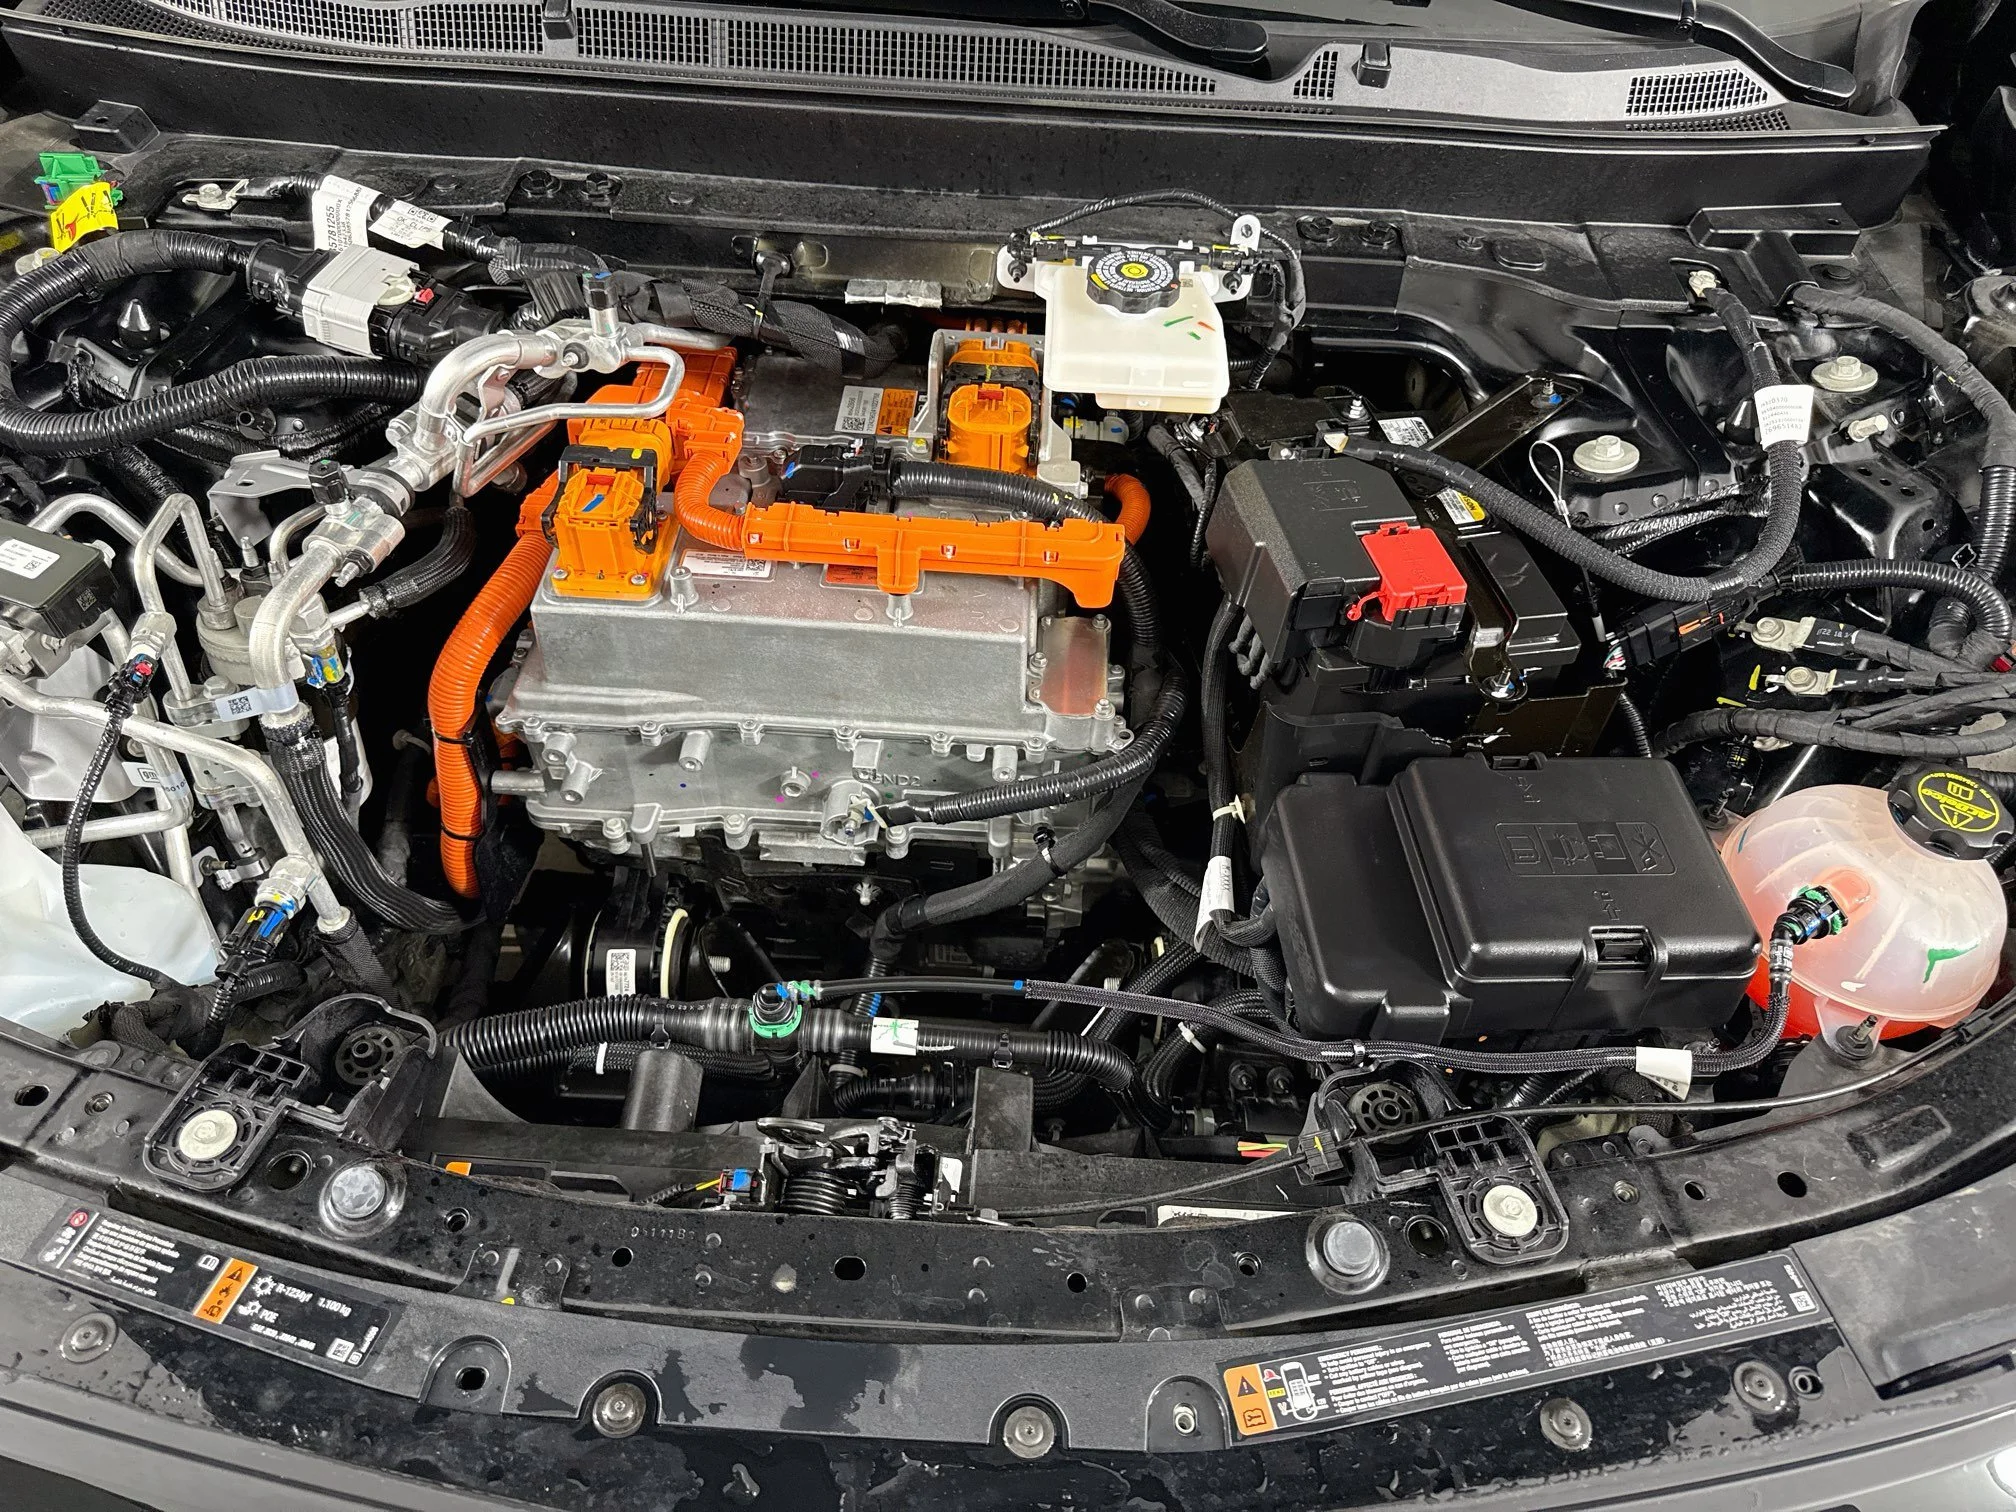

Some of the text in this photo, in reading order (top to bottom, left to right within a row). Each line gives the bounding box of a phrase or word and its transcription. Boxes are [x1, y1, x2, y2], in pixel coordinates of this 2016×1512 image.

[143, 770, 157, 780] gm
[871, 774, 921, 787] GND2
[1921, 788, 1995, 820] ACDelco
[275, 1283, 351, 1317] R-1234yf 1.100 kg
[259, 1309, 279, 1323] POE
